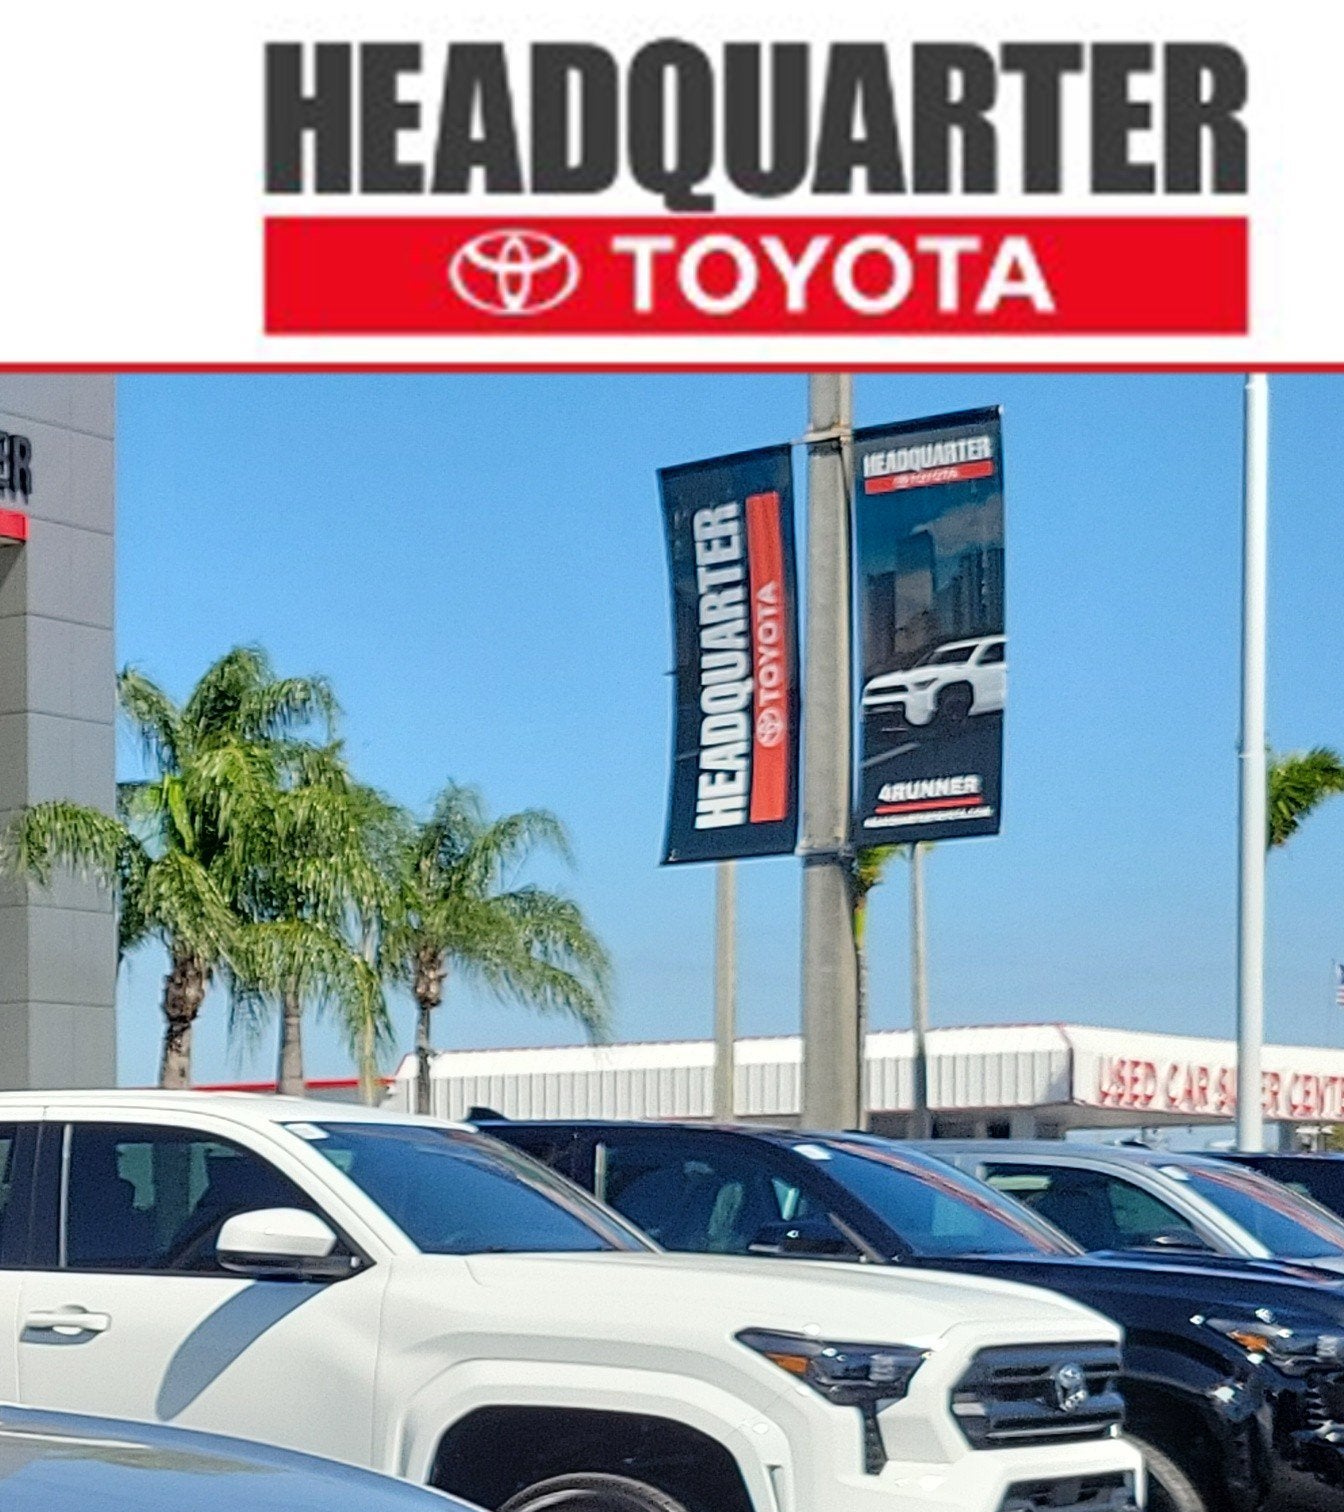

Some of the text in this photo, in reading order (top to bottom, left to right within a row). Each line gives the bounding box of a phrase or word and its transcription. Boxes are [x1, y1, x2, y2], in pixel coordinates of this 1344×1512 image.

[863, 435, 991, 478] HEADQUARTER
[693, 500, 754, 829] HEADQUARTER
[758, 580, 779, 708] TOYOTA
[877, 774, 983, 802] 4RUNNER
[1098, 1055, 1156, 1107] USED
[1166, 1062, 1208, 1111] CAR
